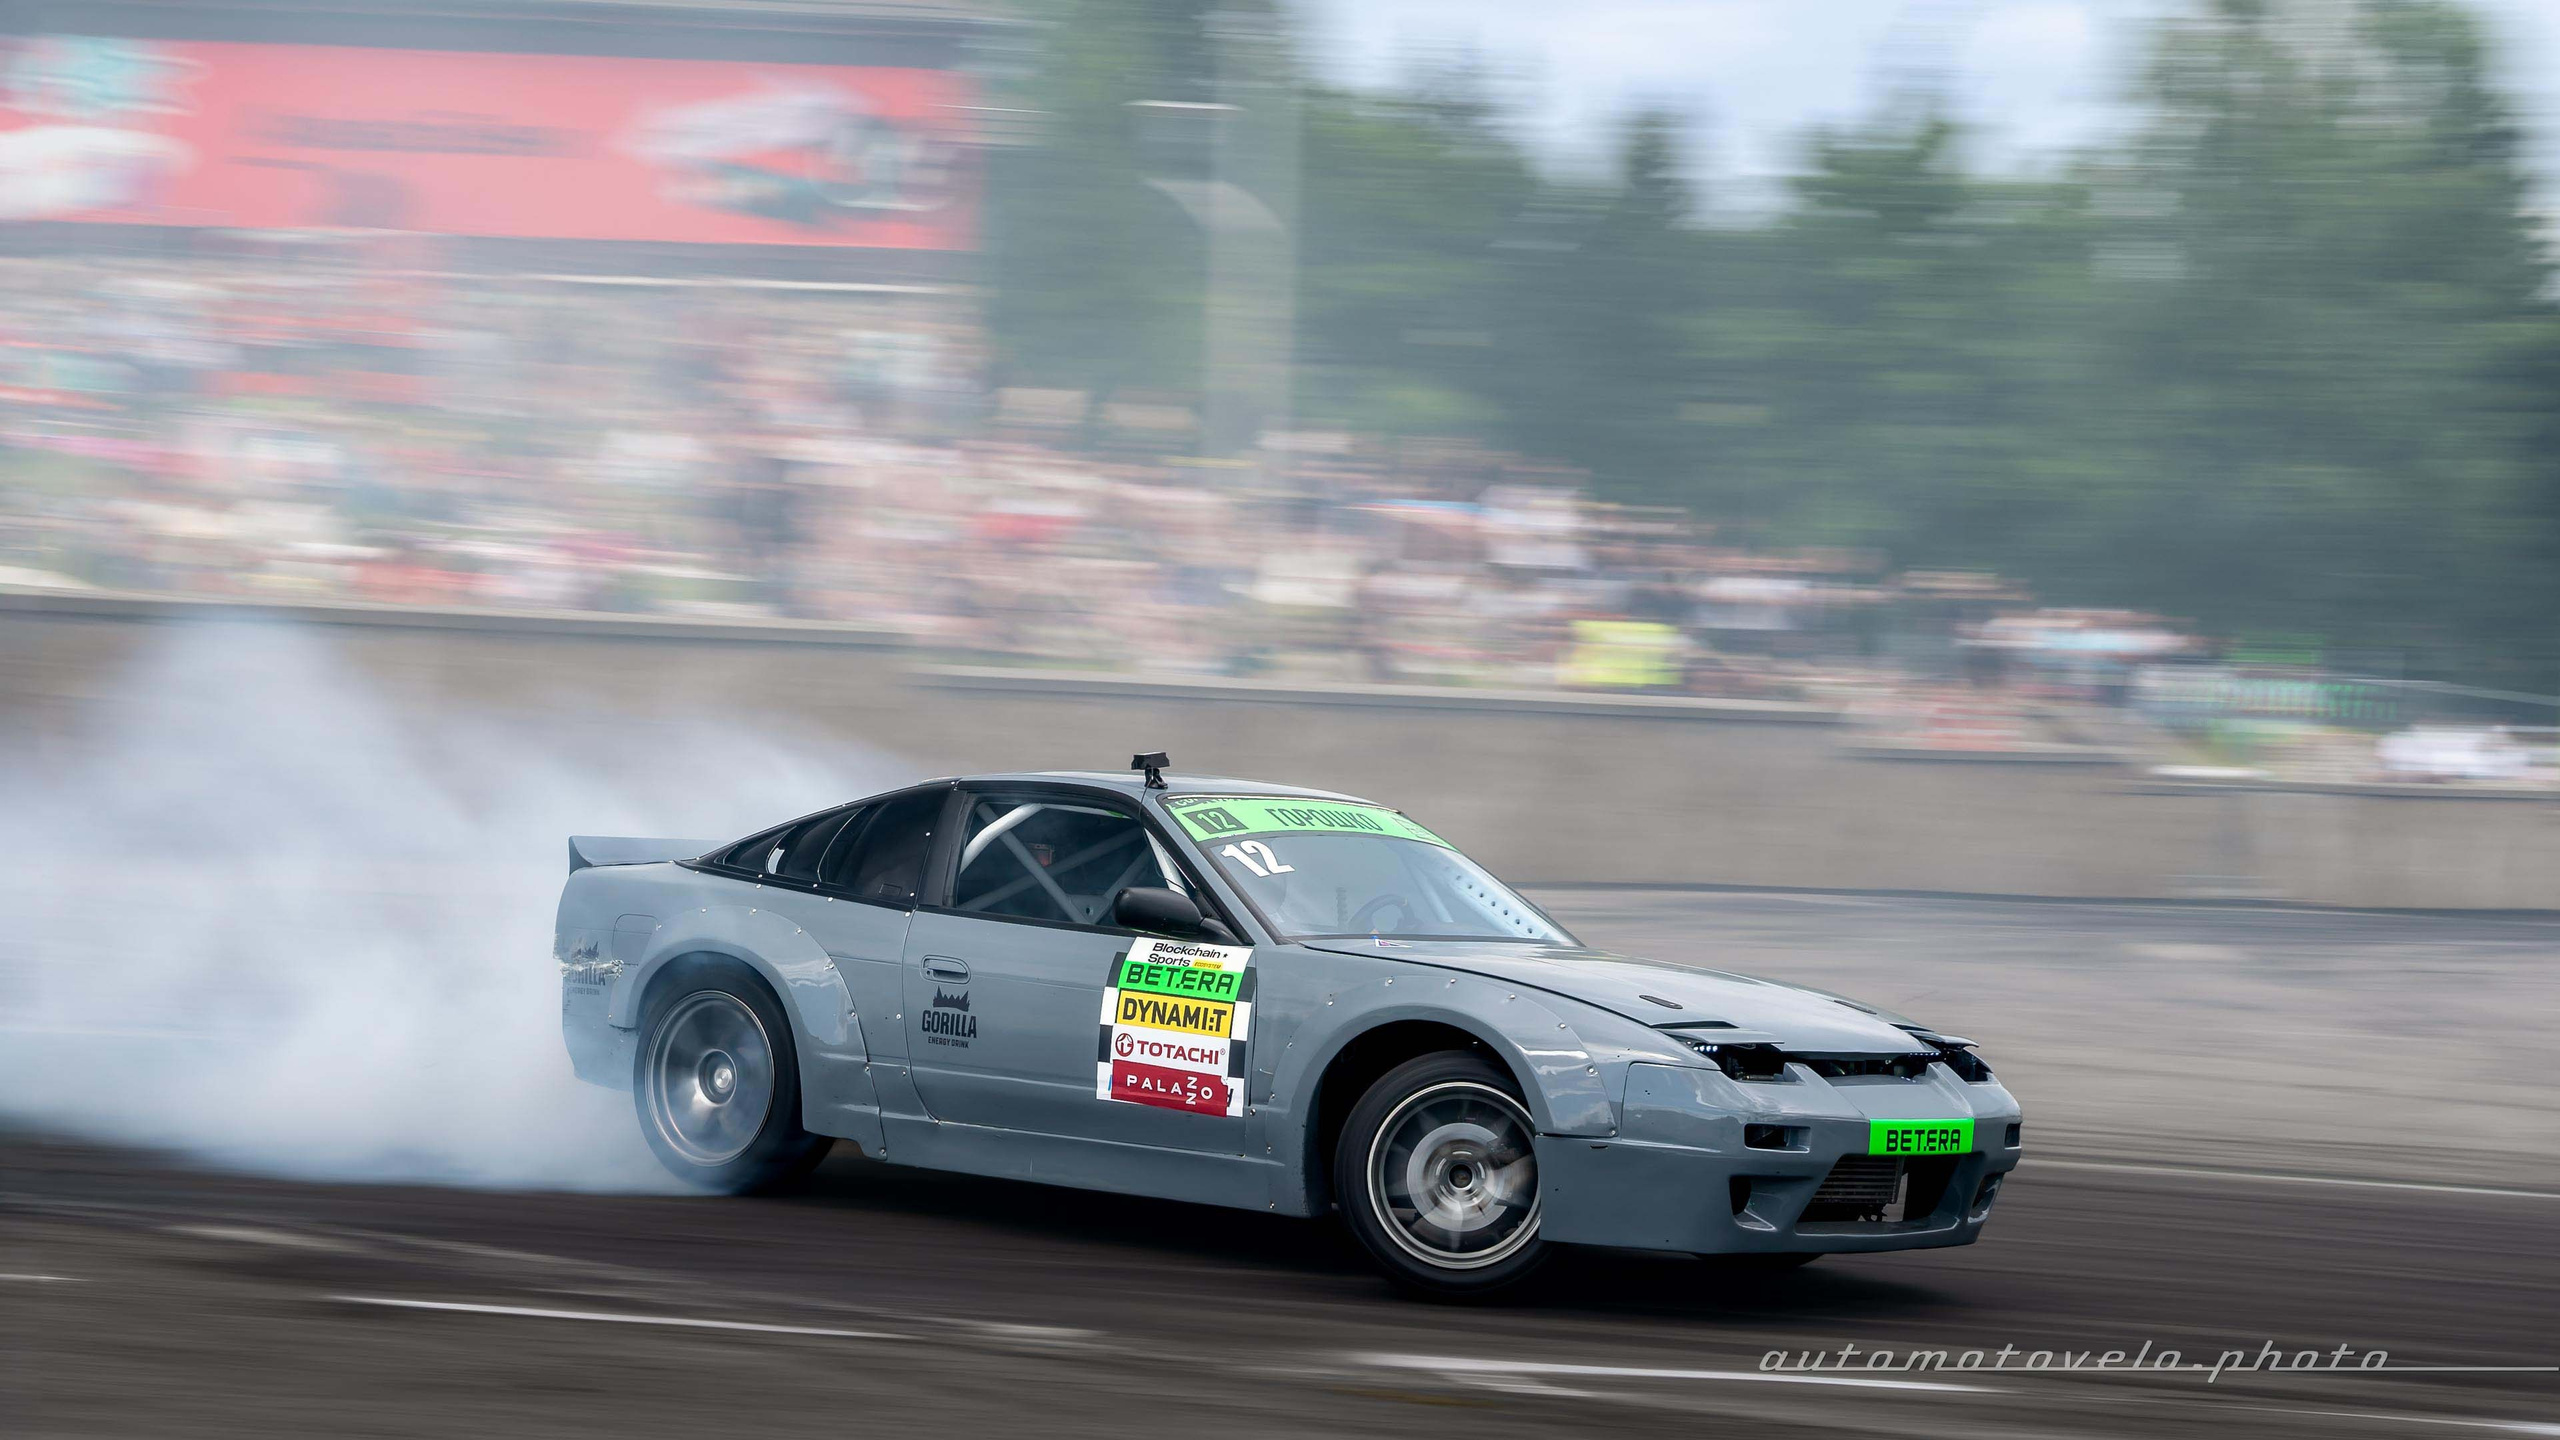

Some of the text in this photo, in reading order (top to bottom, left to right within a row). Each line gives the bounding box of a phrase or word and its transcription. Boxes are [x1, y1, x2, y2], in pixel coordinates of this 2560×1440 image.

[1197, 811, 1237, 830] 12
[1264, 808, 1384, 831] ГОРОШКО
[1219, 839, 1295, 878] 12
[1147, 953, 1222, 970] Sports ECOSYSTEM
[1152, 942, 1221, 959] Blockchain
[922, 1009, 977, 1039] GORILLA
[928, 1036, 969, 1049] ENERGY DRINK
[1137, 1040, 1219, 1065] TOTACHI
[1126, 1074, 1213, 1106] PALAZZO
